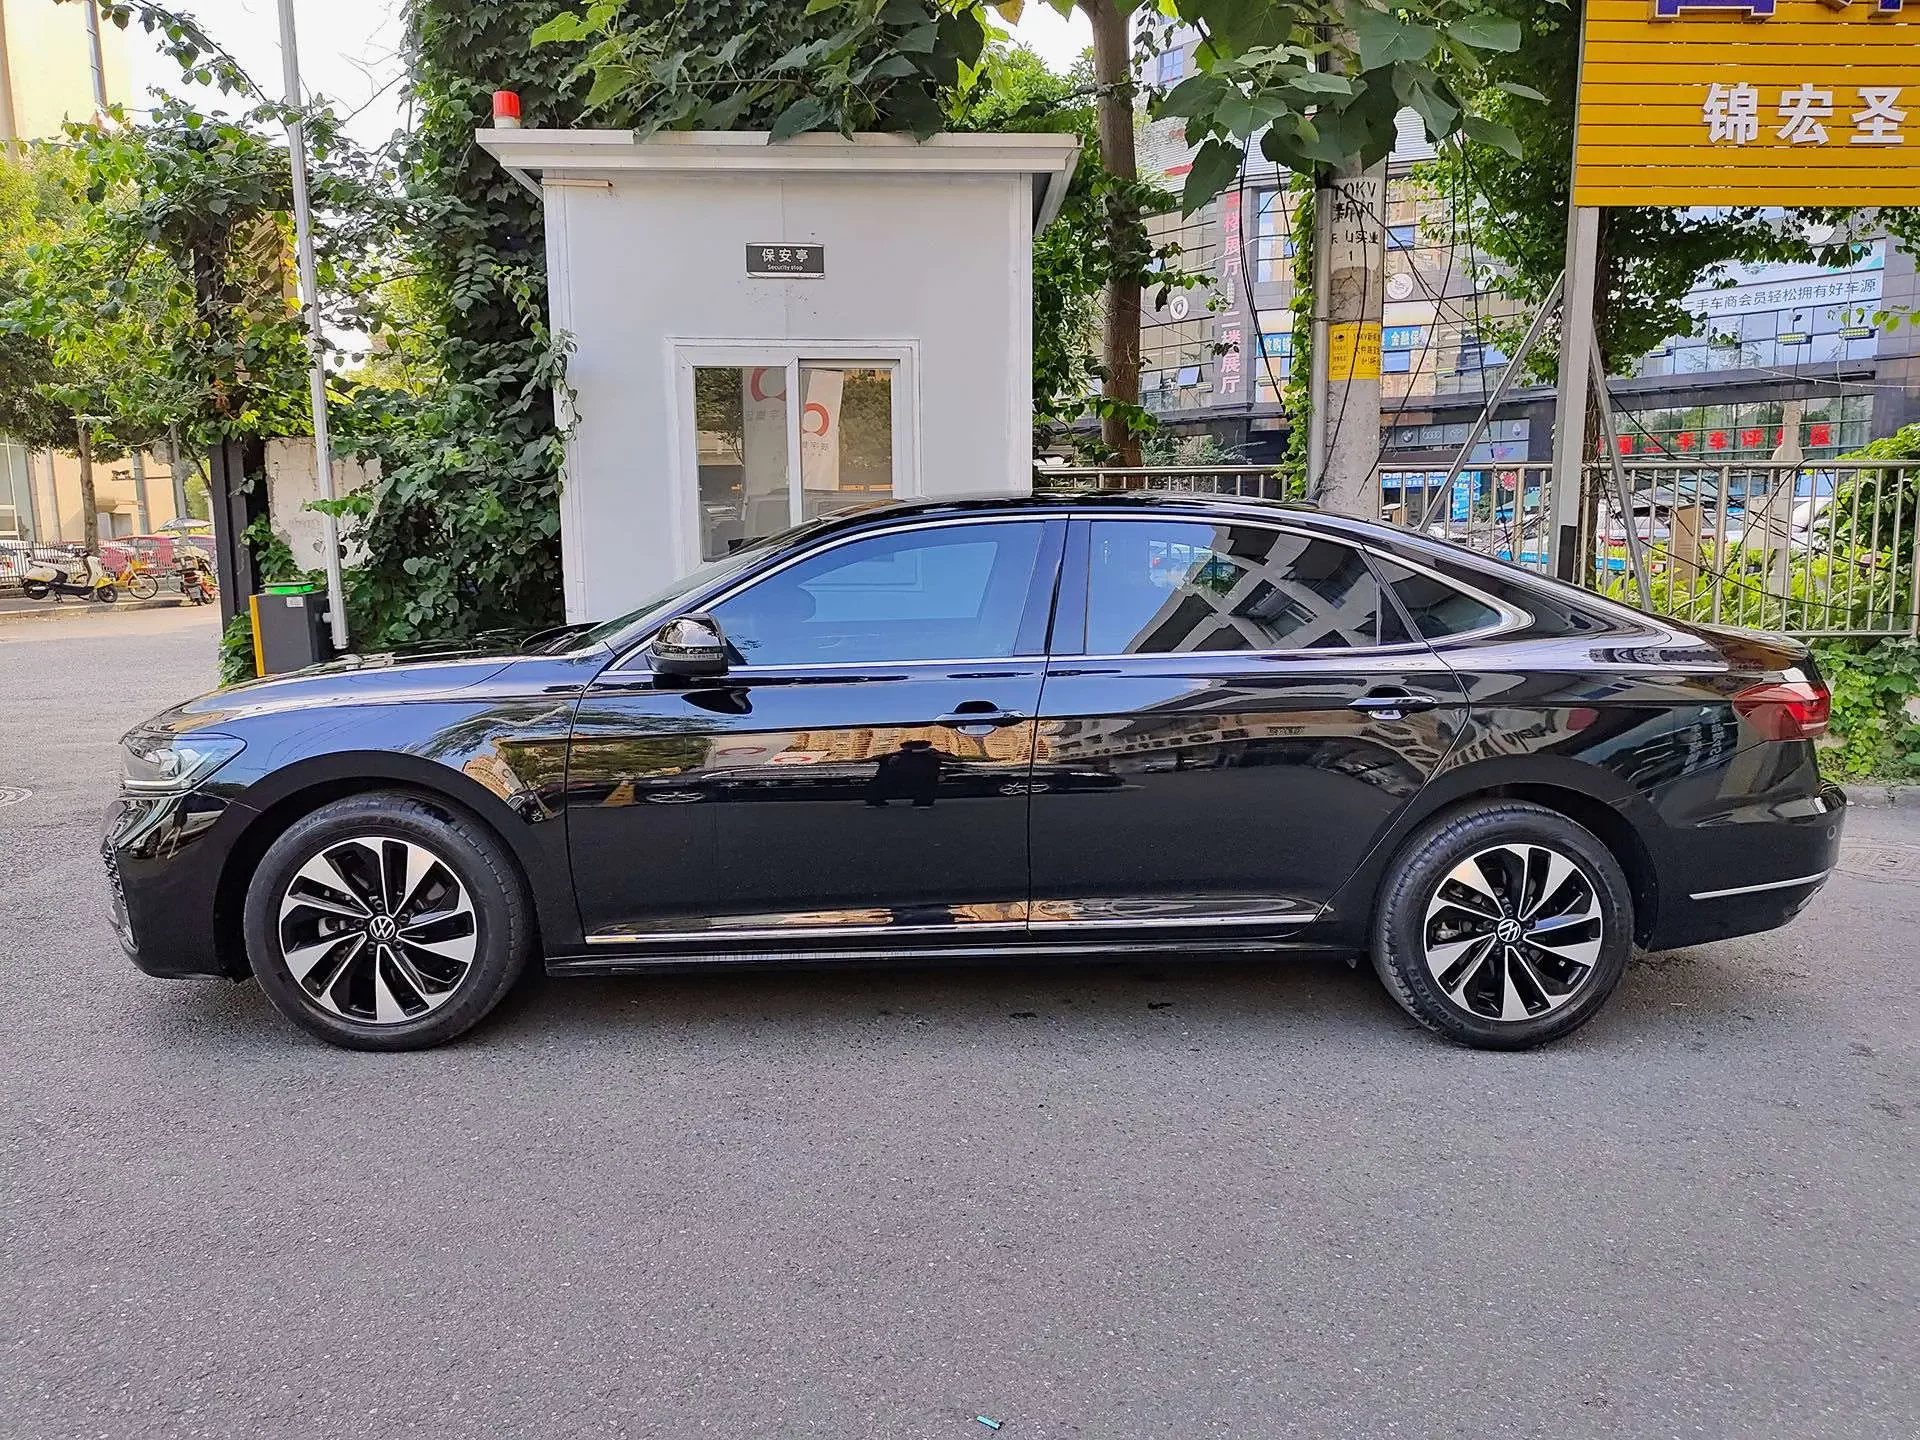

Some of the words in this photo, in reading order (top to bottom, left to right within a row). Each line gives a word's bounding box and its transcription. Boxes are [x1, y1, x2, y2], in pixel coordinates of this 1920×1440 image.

[1702, 81, 1909, 145] 锦宏圣
[761, 248, 808, 262] 保安亭
